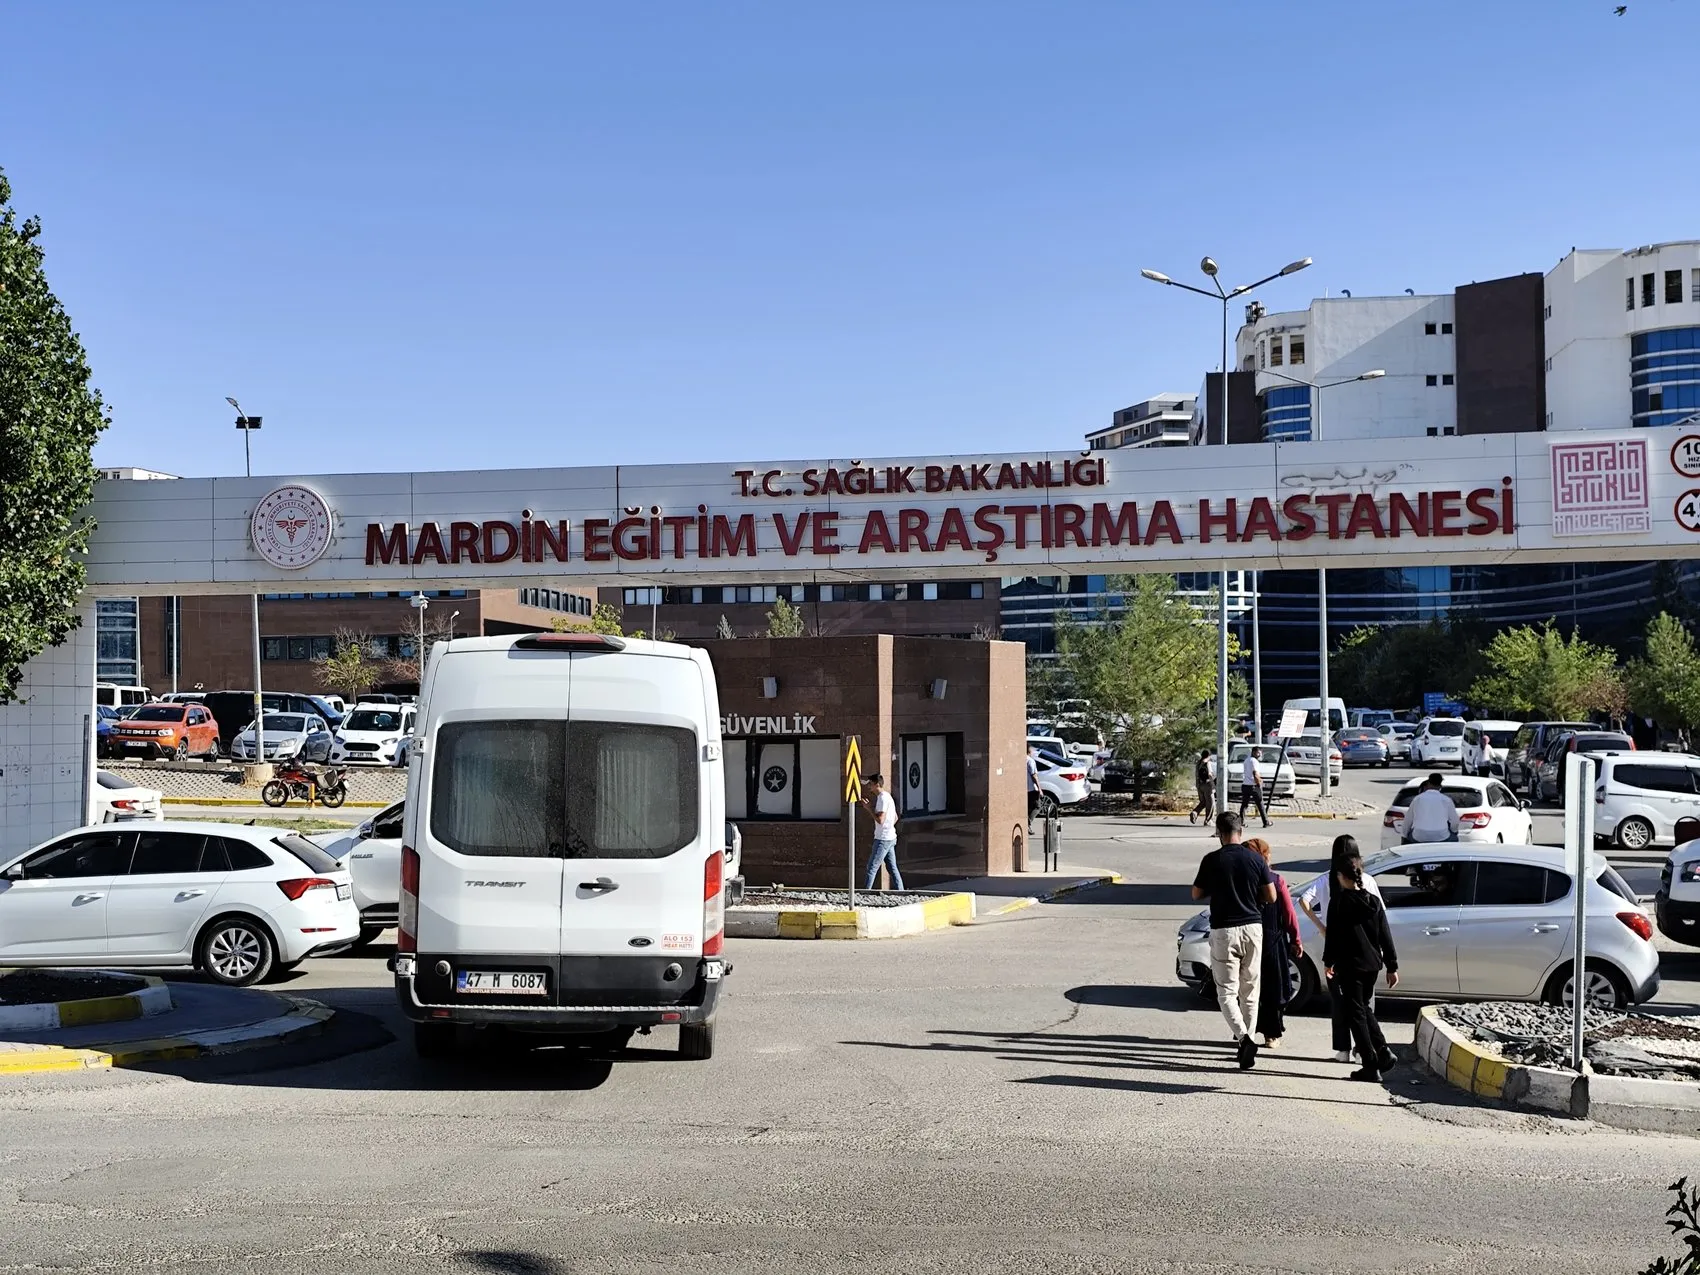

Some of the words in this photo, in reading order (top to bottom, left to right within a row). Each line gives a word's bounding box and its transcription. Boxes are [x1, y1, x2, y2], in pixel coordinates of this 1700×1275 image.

[734, 469, 793, 497] T.C.
[803, 460, 916, 496] SAĞLIK
[925, 452, 1105, 493] BAKANLIĞI
[365, 509, 569, 565] MARDİN
[584, 503, 757, 561] EĞİTİM
[772, 511, 840, 556] VE
[858, 500, 1184, 562] ARAŞTIRMA
[1199, 476, 1515, 544] HASTANESİ
[464, 880, 527, 888] TRANSIT
[466, 973, 482, 987] 47
[493, 973, 501, 987] M
[512, 973, 544, 989] 6087
